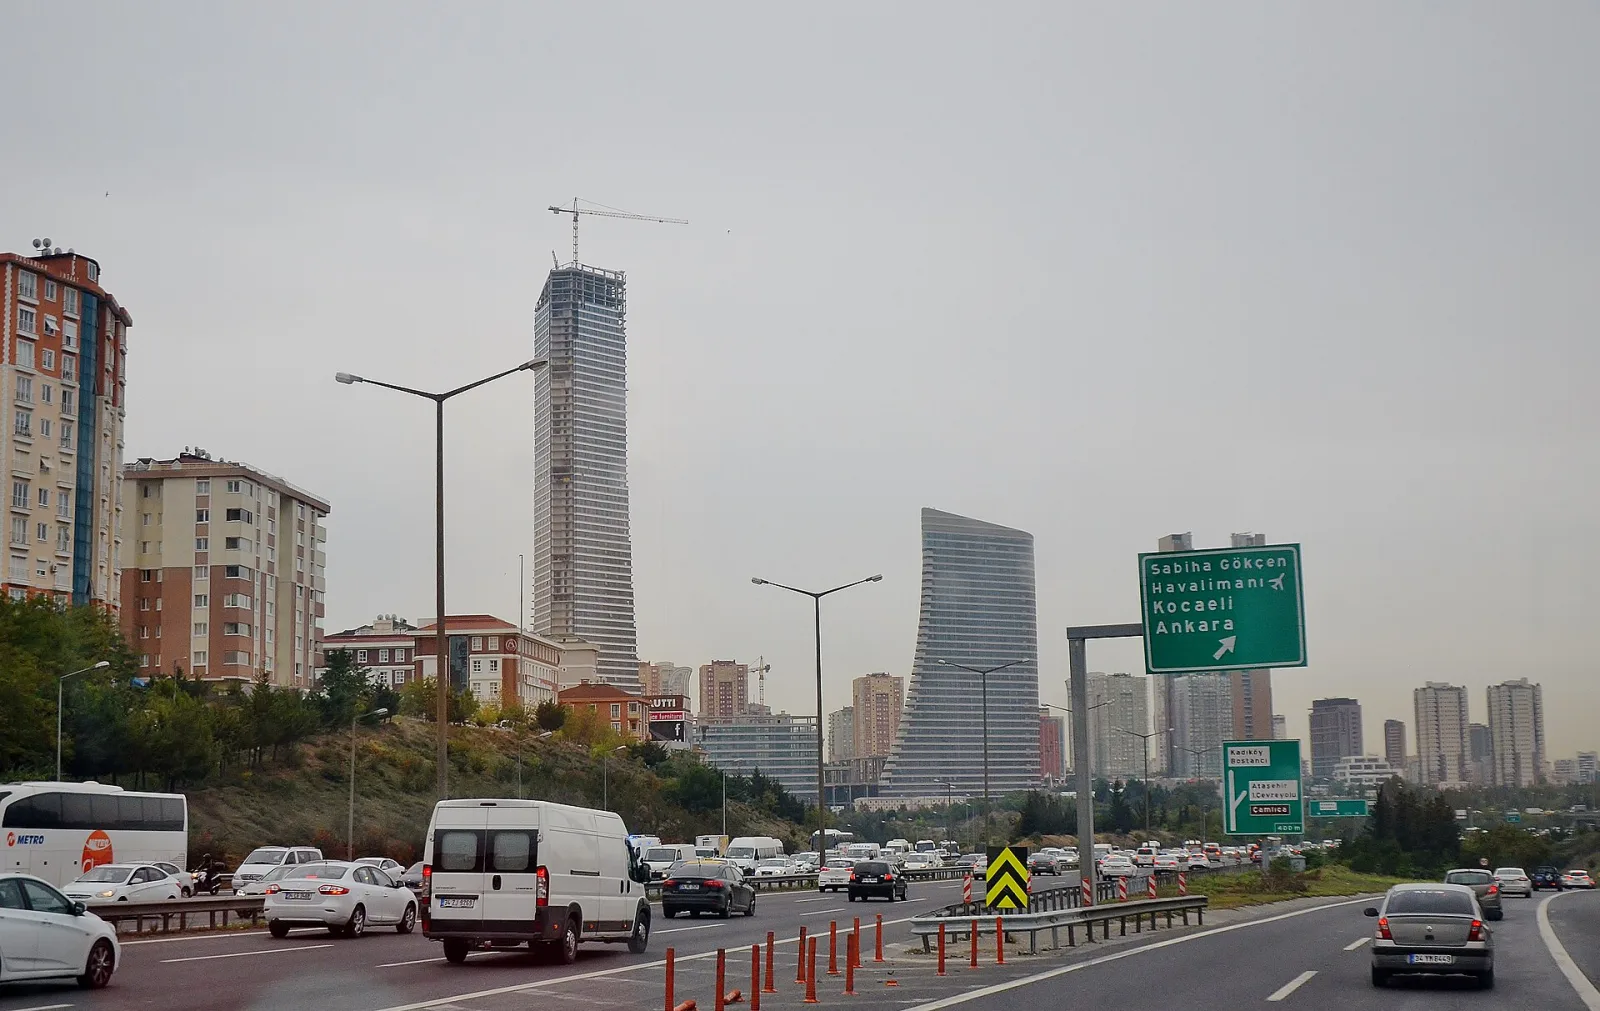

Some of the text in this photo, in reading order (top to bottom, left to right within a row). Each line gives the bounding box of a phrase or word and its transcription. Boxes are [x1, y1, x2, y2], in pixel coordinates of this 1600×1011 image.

[1151, 557, 1287, 575] Sabiha Gökçen
[1152, 578, 1264, 594] Havalimanı
[1153, 596, 1233, 614] Kocaeli
[1156, 619, 1234, 634] Ankara
[17, 835, 45, 845] METRO
